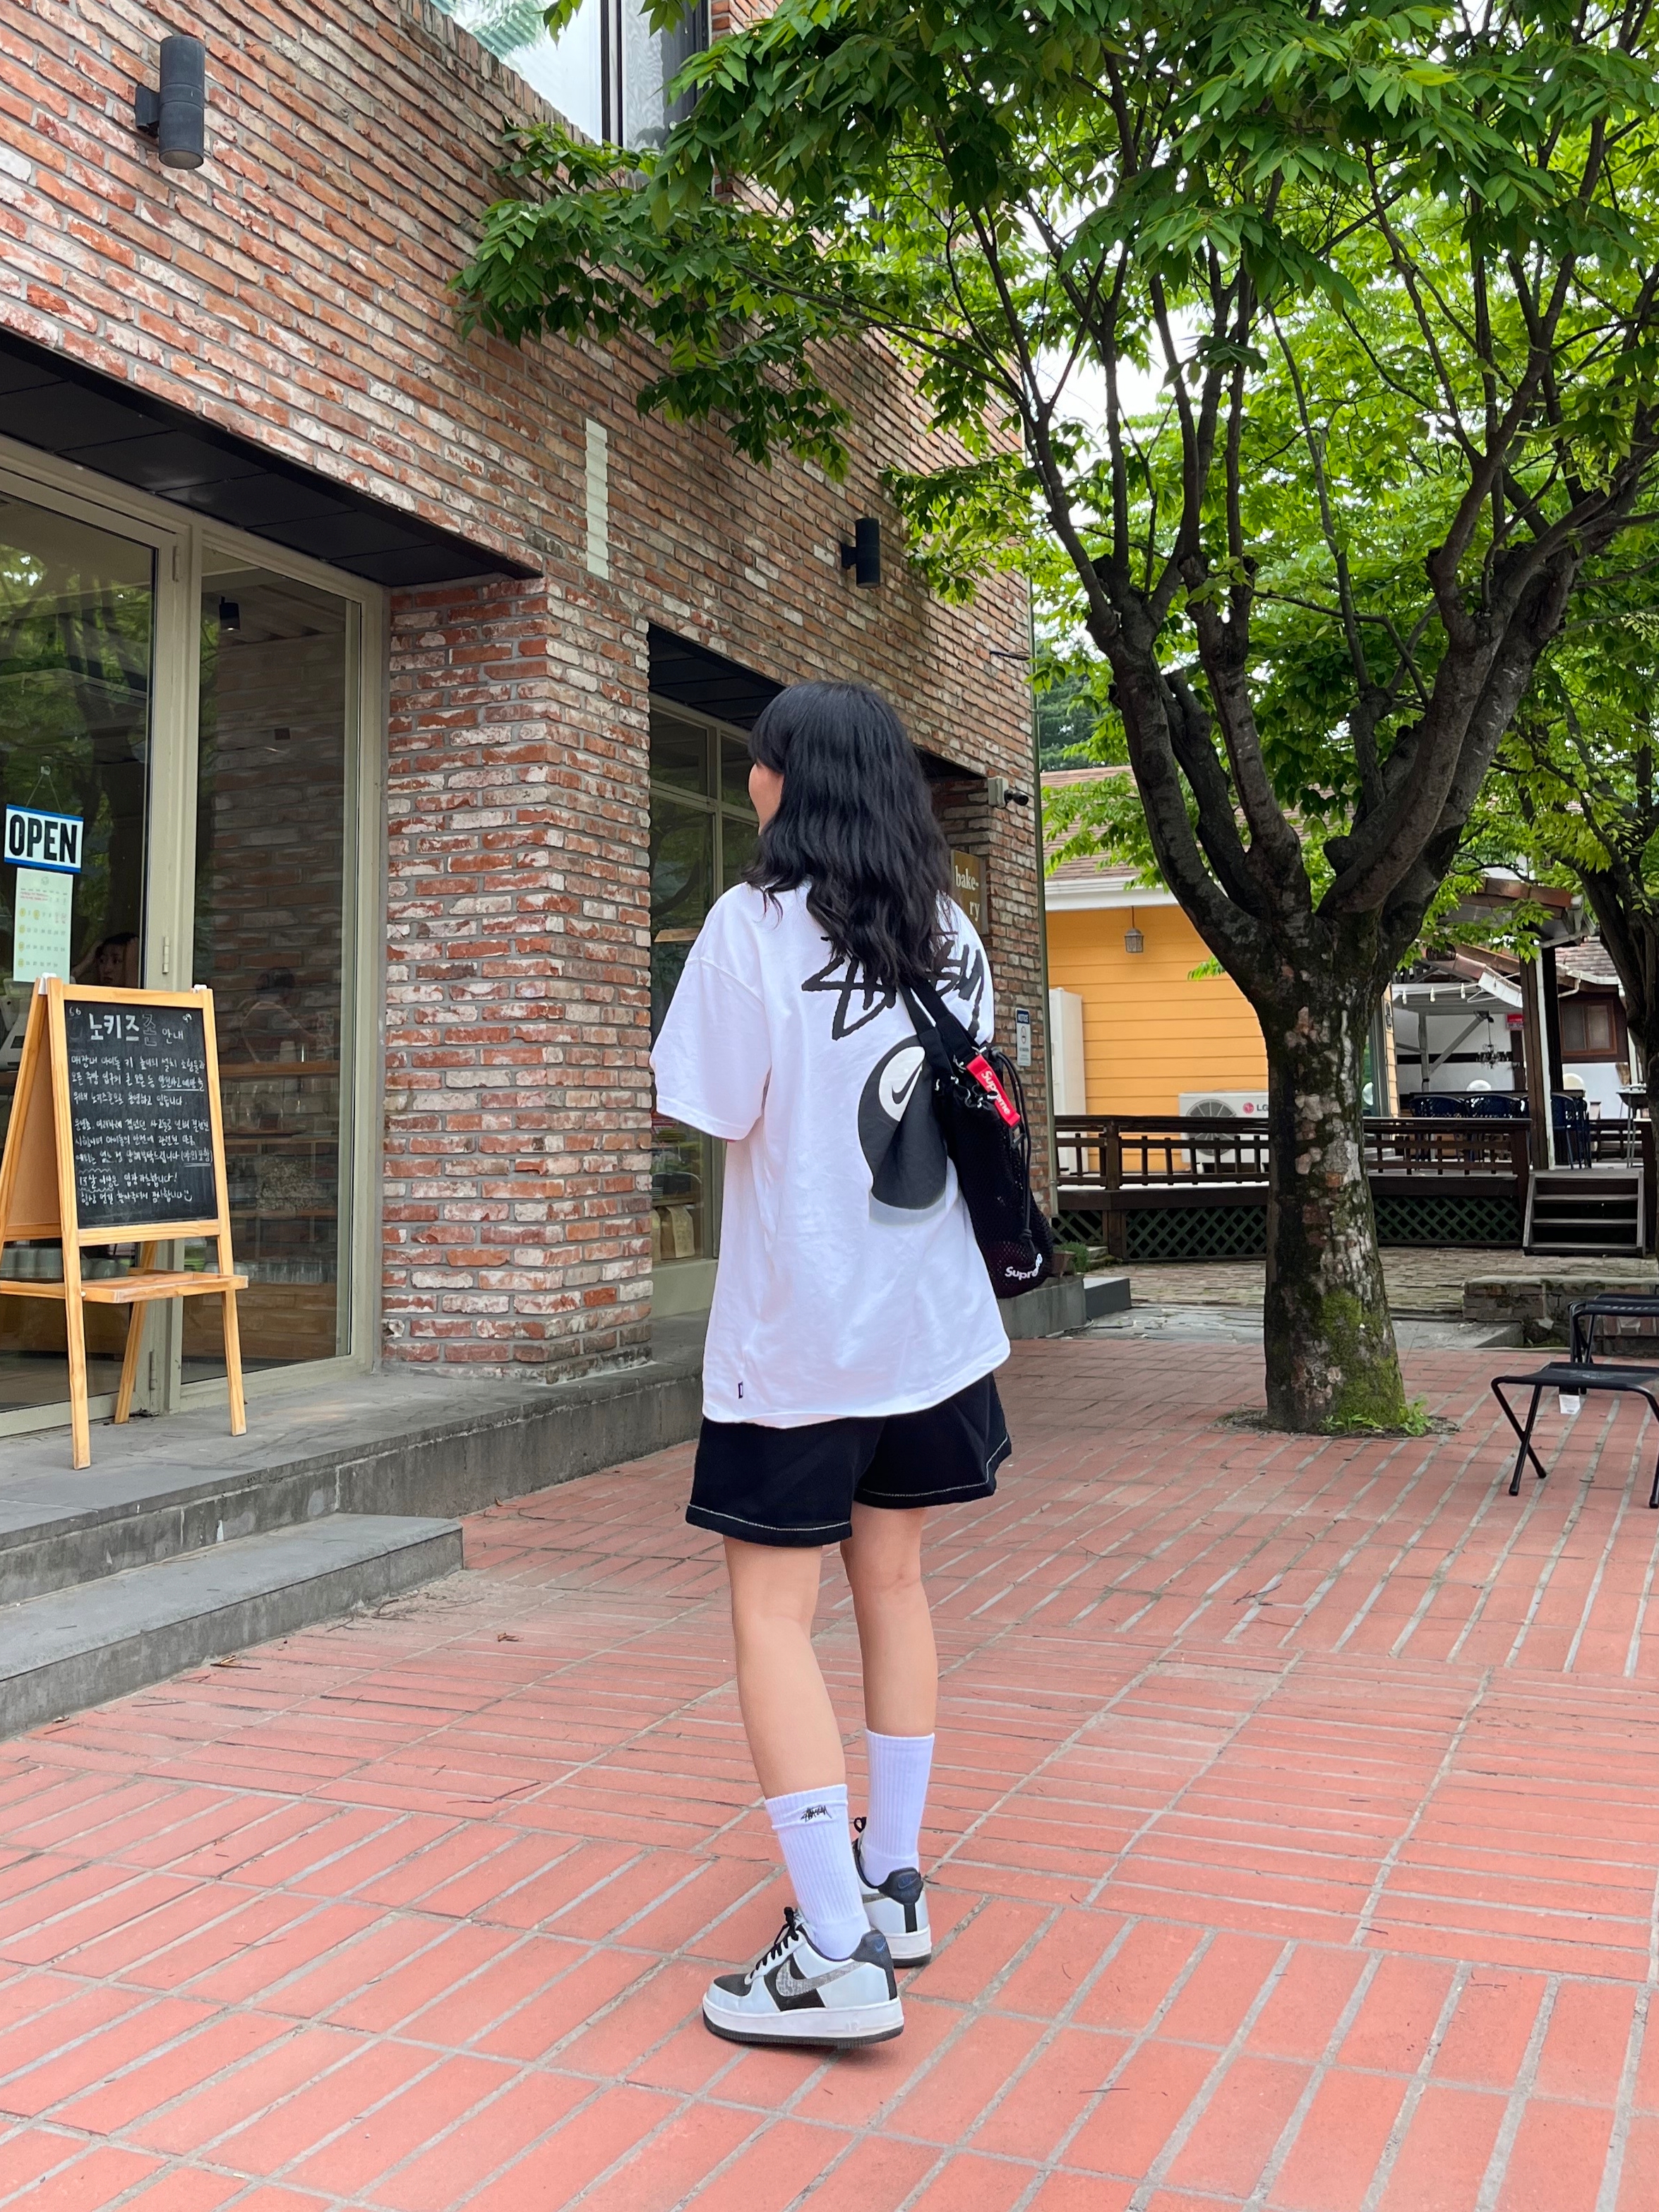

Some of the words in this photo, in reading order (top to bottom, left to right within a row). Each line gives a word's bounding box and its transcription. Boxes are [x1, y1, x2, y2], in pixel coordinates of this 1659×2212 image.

[9, 814, 78, 864] OPEN
[969, 901, 980, 922] ry
[89, 1012, 157, 1047] 노키즈존
[162, 1028, 184, 1045] 안내
[71, 1055, 97, 1068] 매장내
[101, 1056, 121, 1070] 아이들
[162, 1058, 177, 1072] 설치
[85, 1070, 99, 1085] 주방
